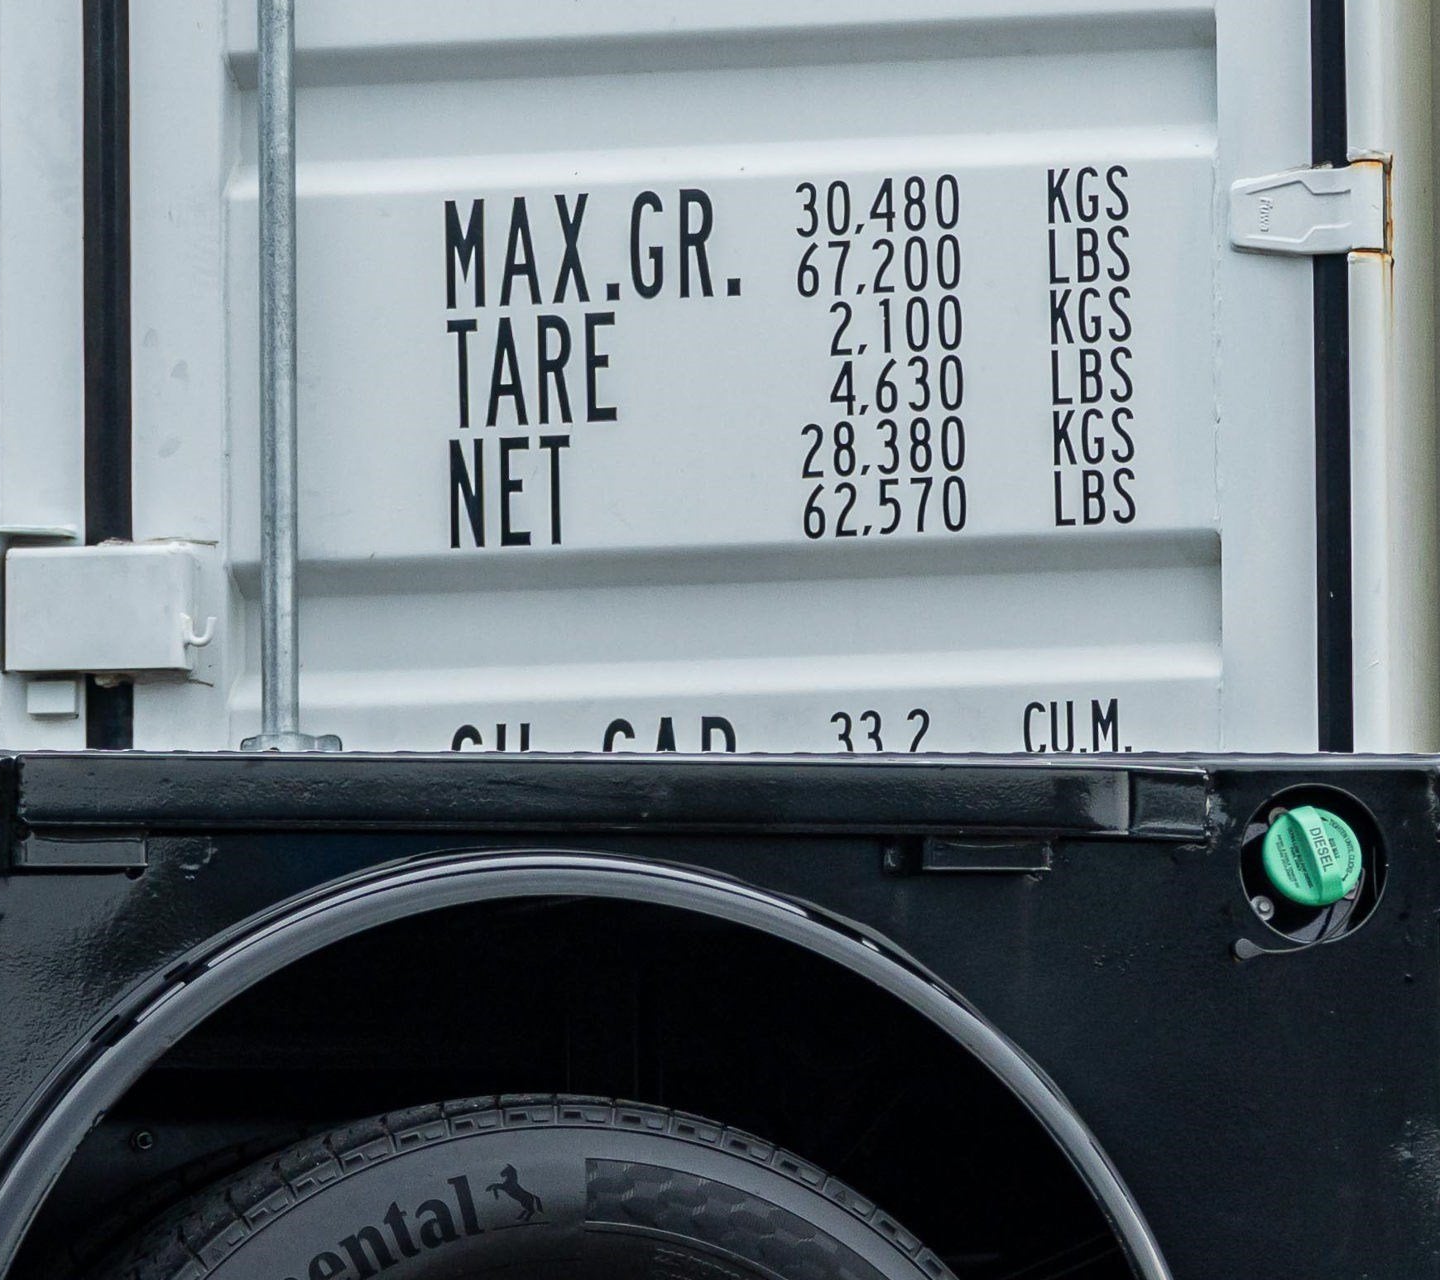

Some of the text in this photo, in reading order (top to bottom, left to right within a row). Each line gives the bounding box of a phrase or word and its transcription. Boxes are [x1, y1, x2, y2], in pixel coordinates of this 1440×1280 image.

[445, 166, 1128, 309] MAX.GR. 30,480 KGS
[798, 226, 1129, 297] 67,200 LBS
[447, 286, 1131, 428] TARE 2,100 KGS
[831, 347, 1132, 415] 4,630 LBS
[450, 407, 1134, 548] NET 28,380 KGS
[804, 468, 1135, 539] 62,570 LBS
[1309, 827, 1333, 872] DIESEL
